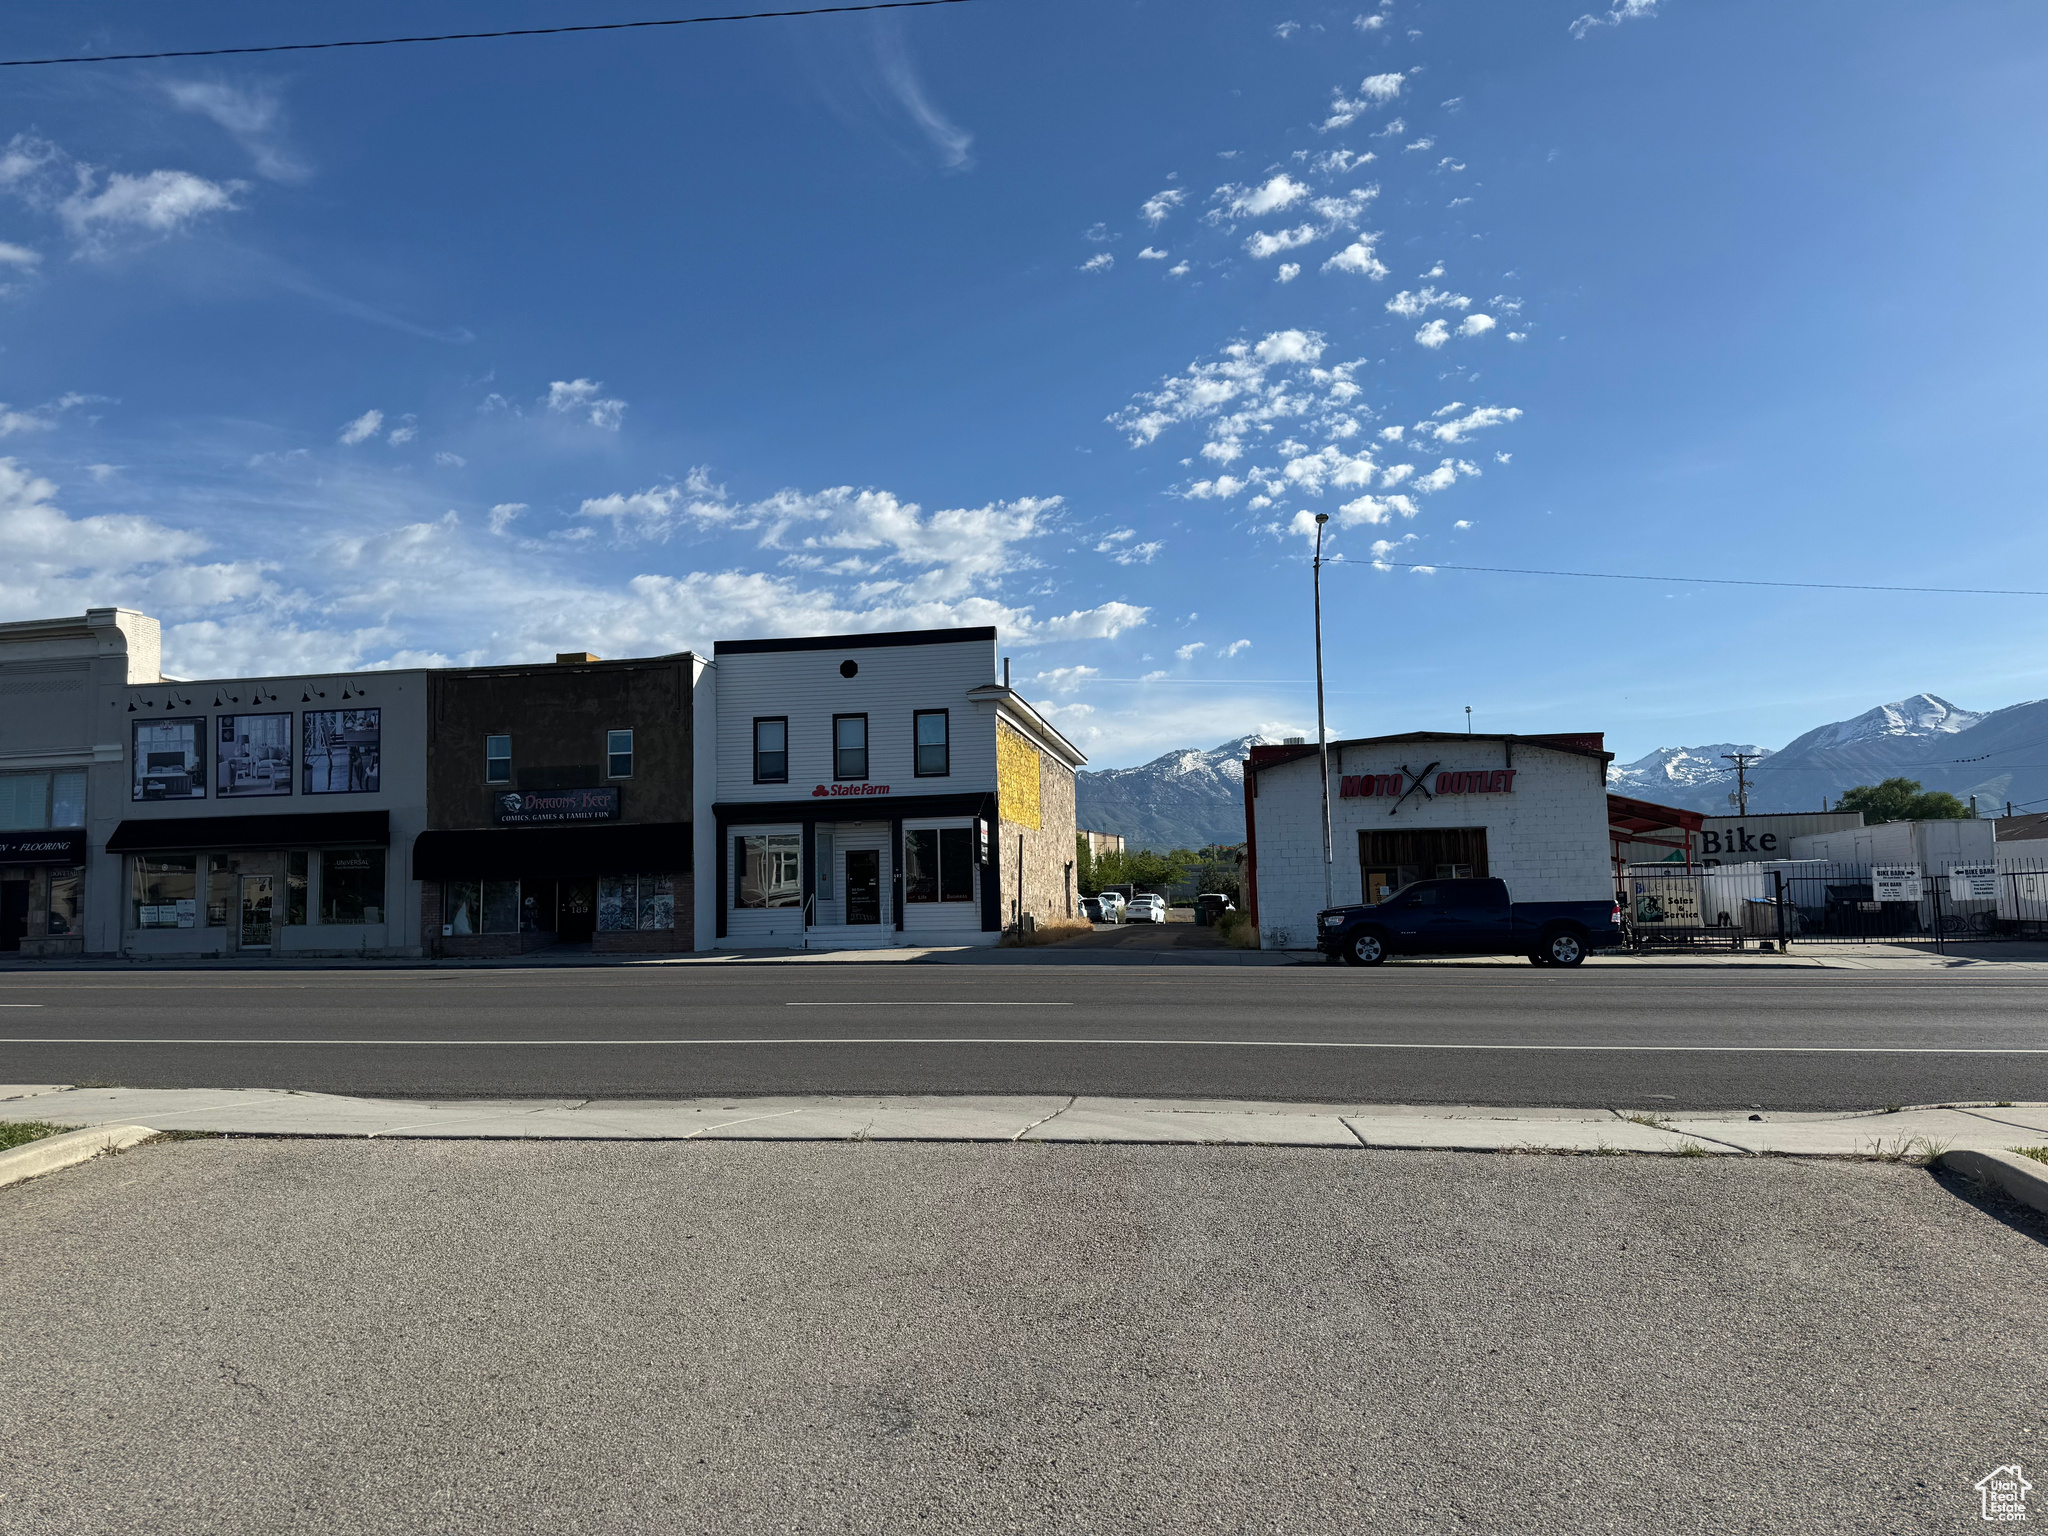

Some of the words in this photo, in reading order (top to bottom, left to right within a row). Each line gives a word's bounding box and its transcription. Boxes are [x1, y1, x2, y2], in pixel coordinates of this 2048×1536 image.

[1340, 774, 1403, 797] MOTO
[1435, 770, 1517, 795] OUTLET
[502, 814, 530, 822] COMICS,
[1700, 826, 1777, 854] Bike
[19, 842, 71, 851] FLOORING
[1668, 896, 1694, 905] Sales
[571, 906, 589, 914] 189
[1664, 910, 1699, 919] Service
